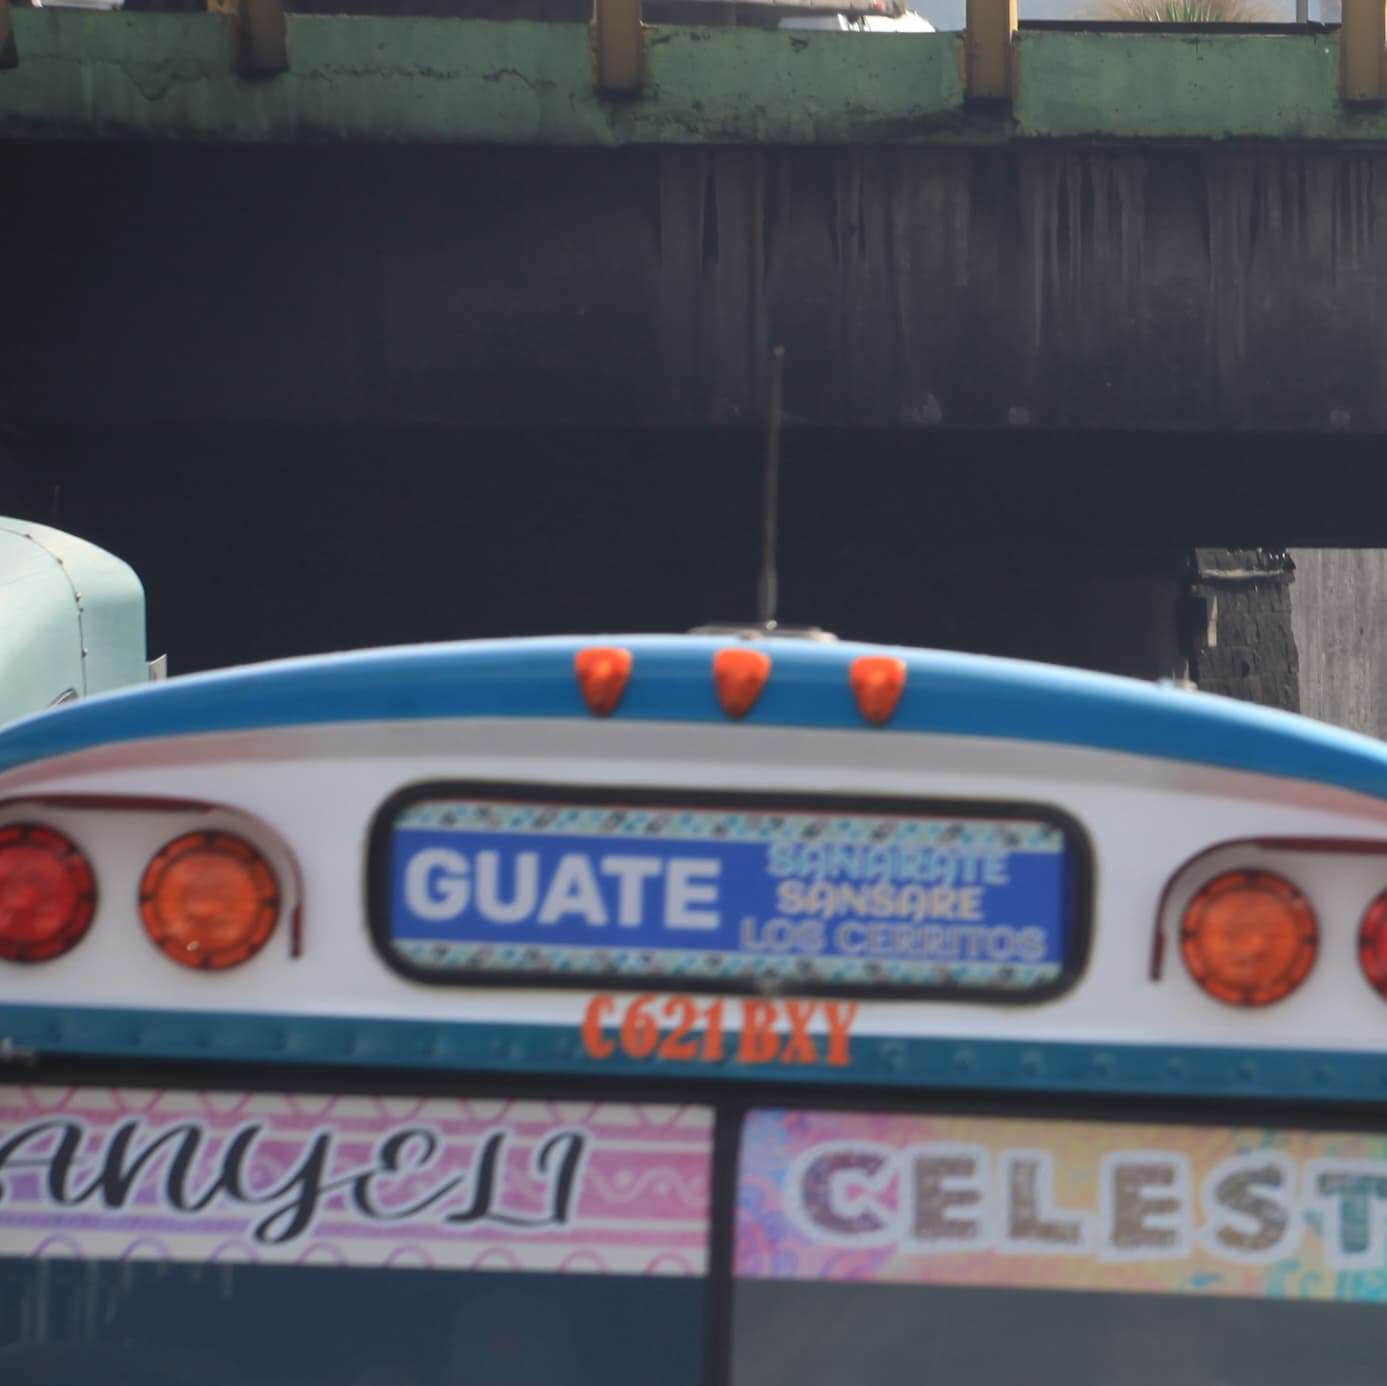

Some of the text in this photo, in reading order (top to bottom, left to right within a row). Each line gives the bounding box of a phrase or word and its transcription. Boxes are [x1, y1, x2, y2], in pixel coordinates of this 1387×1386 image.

[403, 847, 722, 930] GUATE
[776, 881, 985, 921] SANSARE
[739, 917, 1047, 961] LOS CERRITOS
